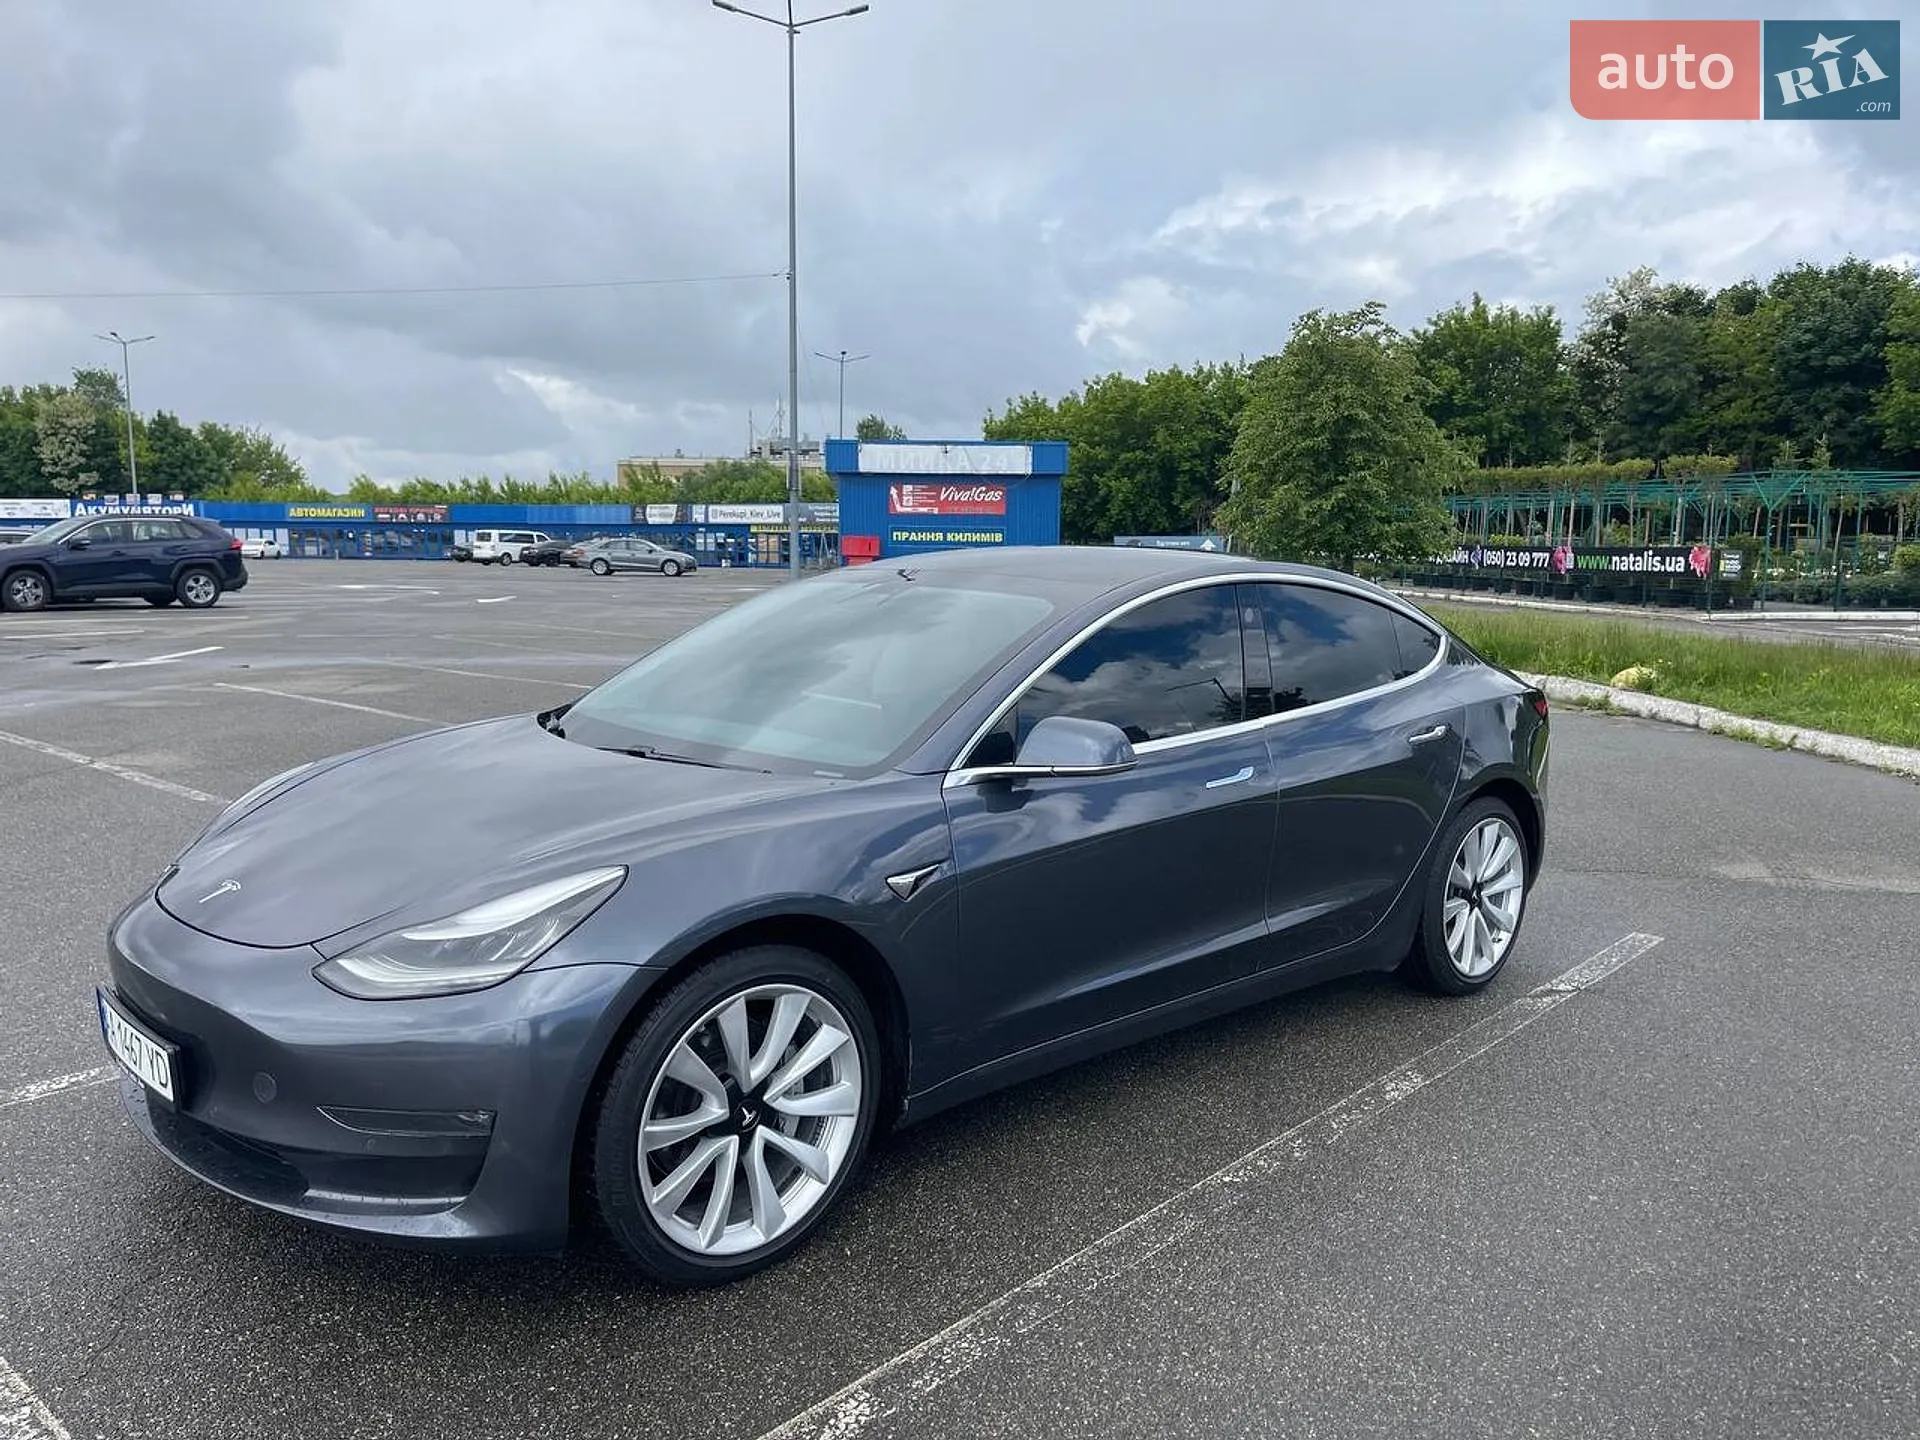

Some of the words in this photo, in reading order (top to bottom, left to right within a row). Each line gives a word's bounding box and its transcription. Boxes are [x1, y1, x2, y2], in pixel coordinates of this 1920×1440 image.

[982, 451, 1008, 470] 24
[939, 486, 1003, 503] Viva!Gas
[289, 508, 365, 518] АВТОМАГАЗИН
[892, 531, 944, 542] ПРАННЯ
[947, 531, 1003, 543] КИЛИМІВ
[1483, 549, 1505, 568] (050)
[1506, 552, 1518, 566] 23
[1518, 552, 1530, 567] 09
[1531, 552, 1550, 567] 777
[1577, 551, 1685, 573] www.natalis.ua
[145, 1043, 168, 1089] YD
